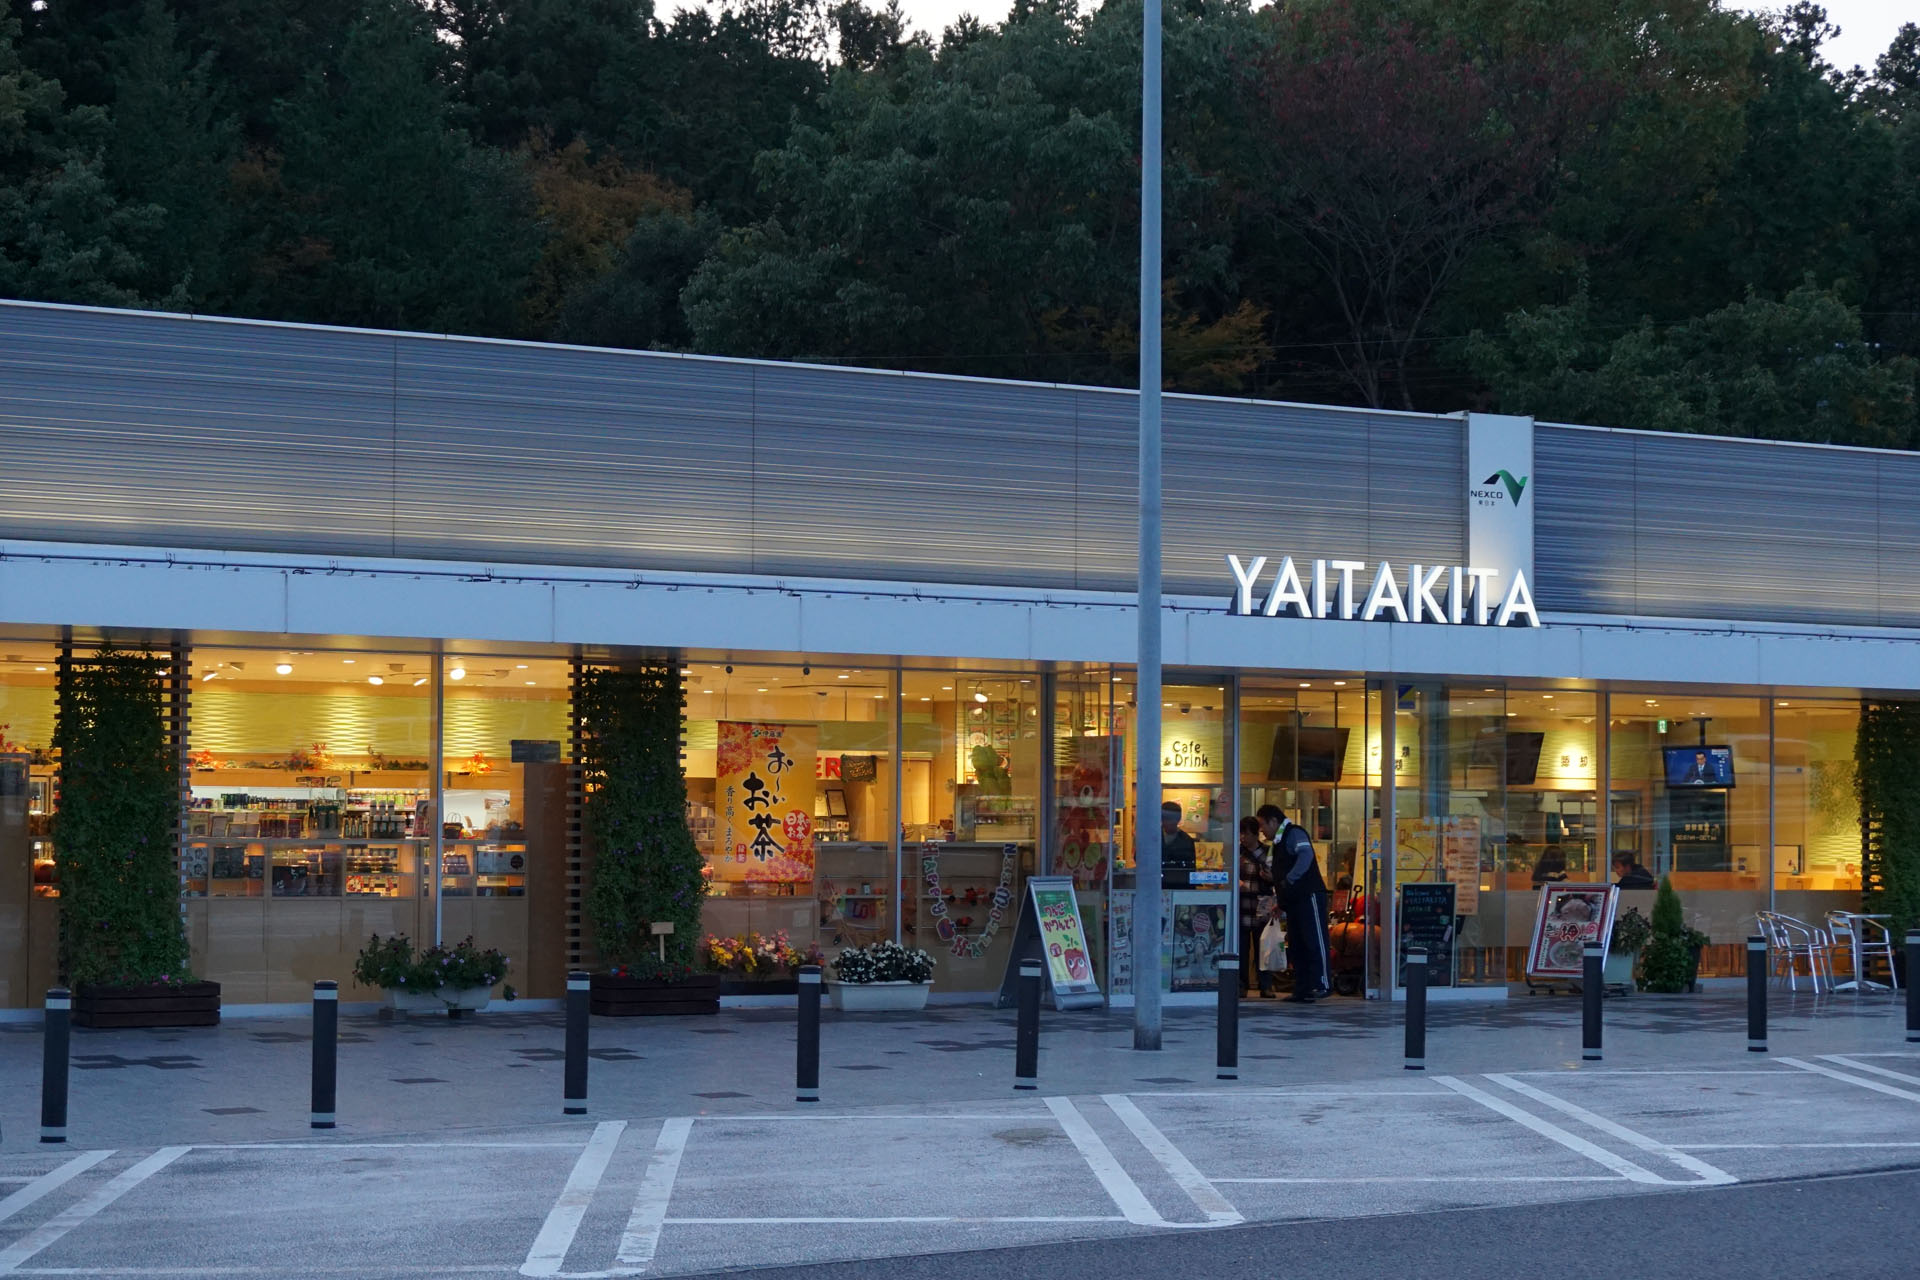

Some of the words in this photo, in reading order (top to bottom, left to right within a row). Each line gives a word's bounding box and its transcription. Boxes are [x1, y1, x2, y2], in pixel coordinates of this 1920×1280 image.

[1470, 490, 1503, 499] NEXCO
[1224, 554, 1541, 628] YAITAKITA
[1173, 741, 1201, 753] Cafe
[1163, 757, 1172, 766] &
[1174, 754, 1209, 767] Drink
